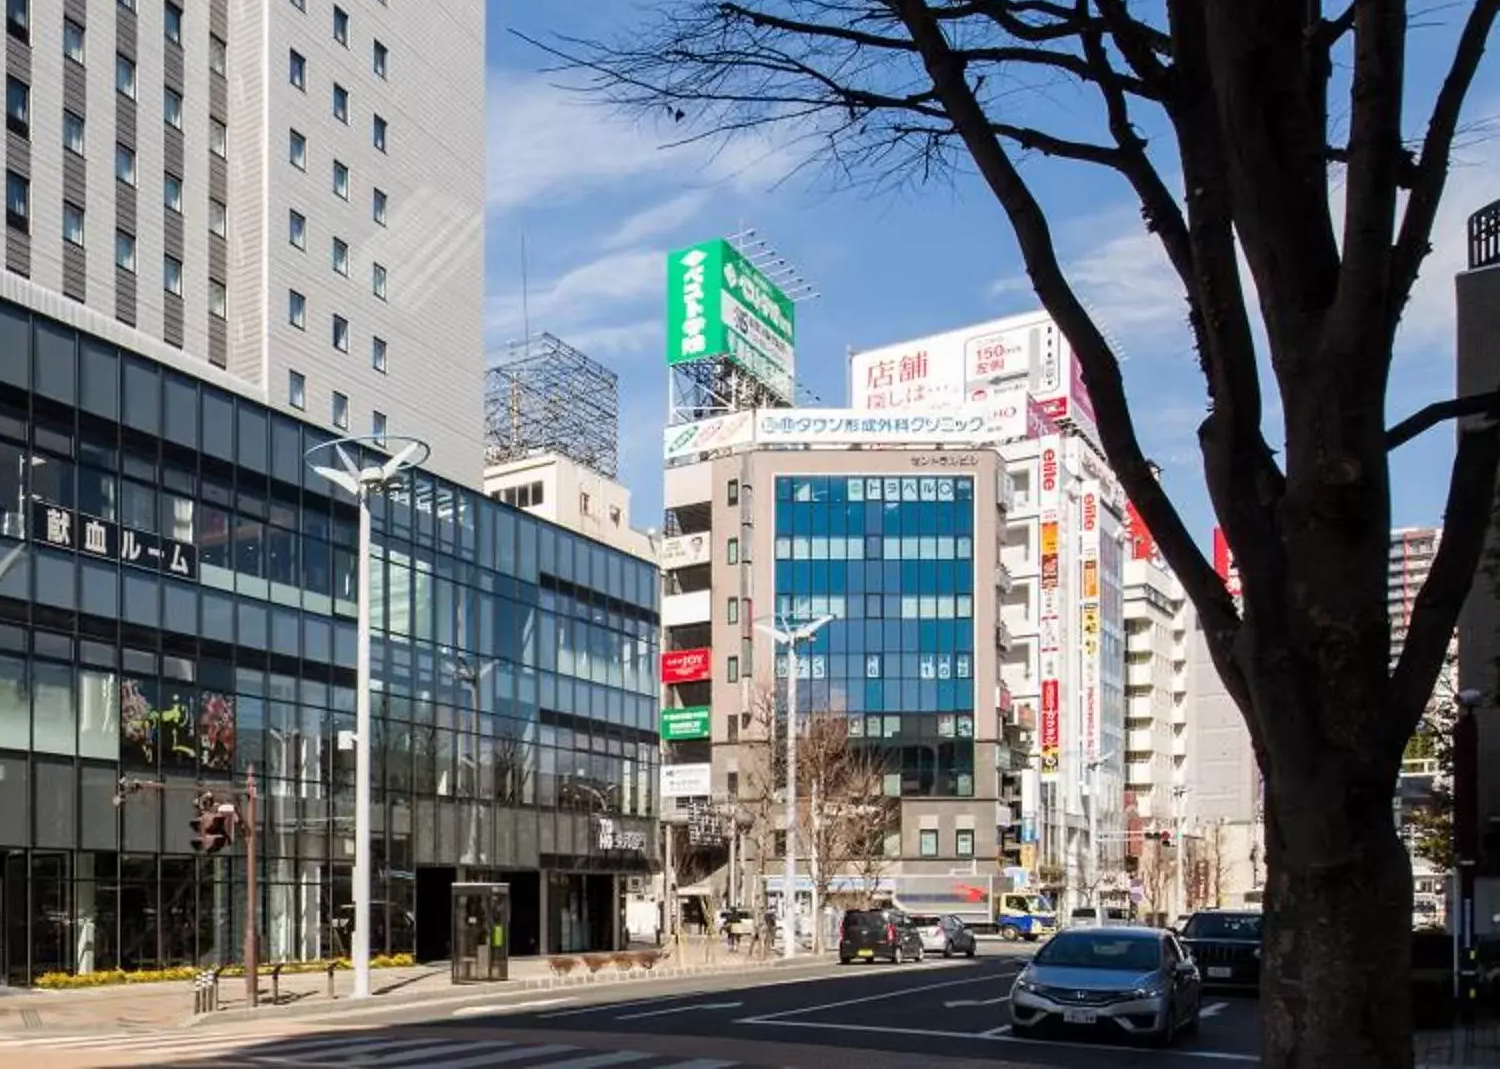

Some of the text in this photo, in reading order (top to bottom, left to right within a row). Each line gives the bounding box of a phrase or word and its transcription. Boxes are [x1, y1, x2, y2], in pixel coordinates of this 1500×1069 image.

[867, 350, 928, 389] 店舗
[46, 508, 189, 575] 献血ルーム
